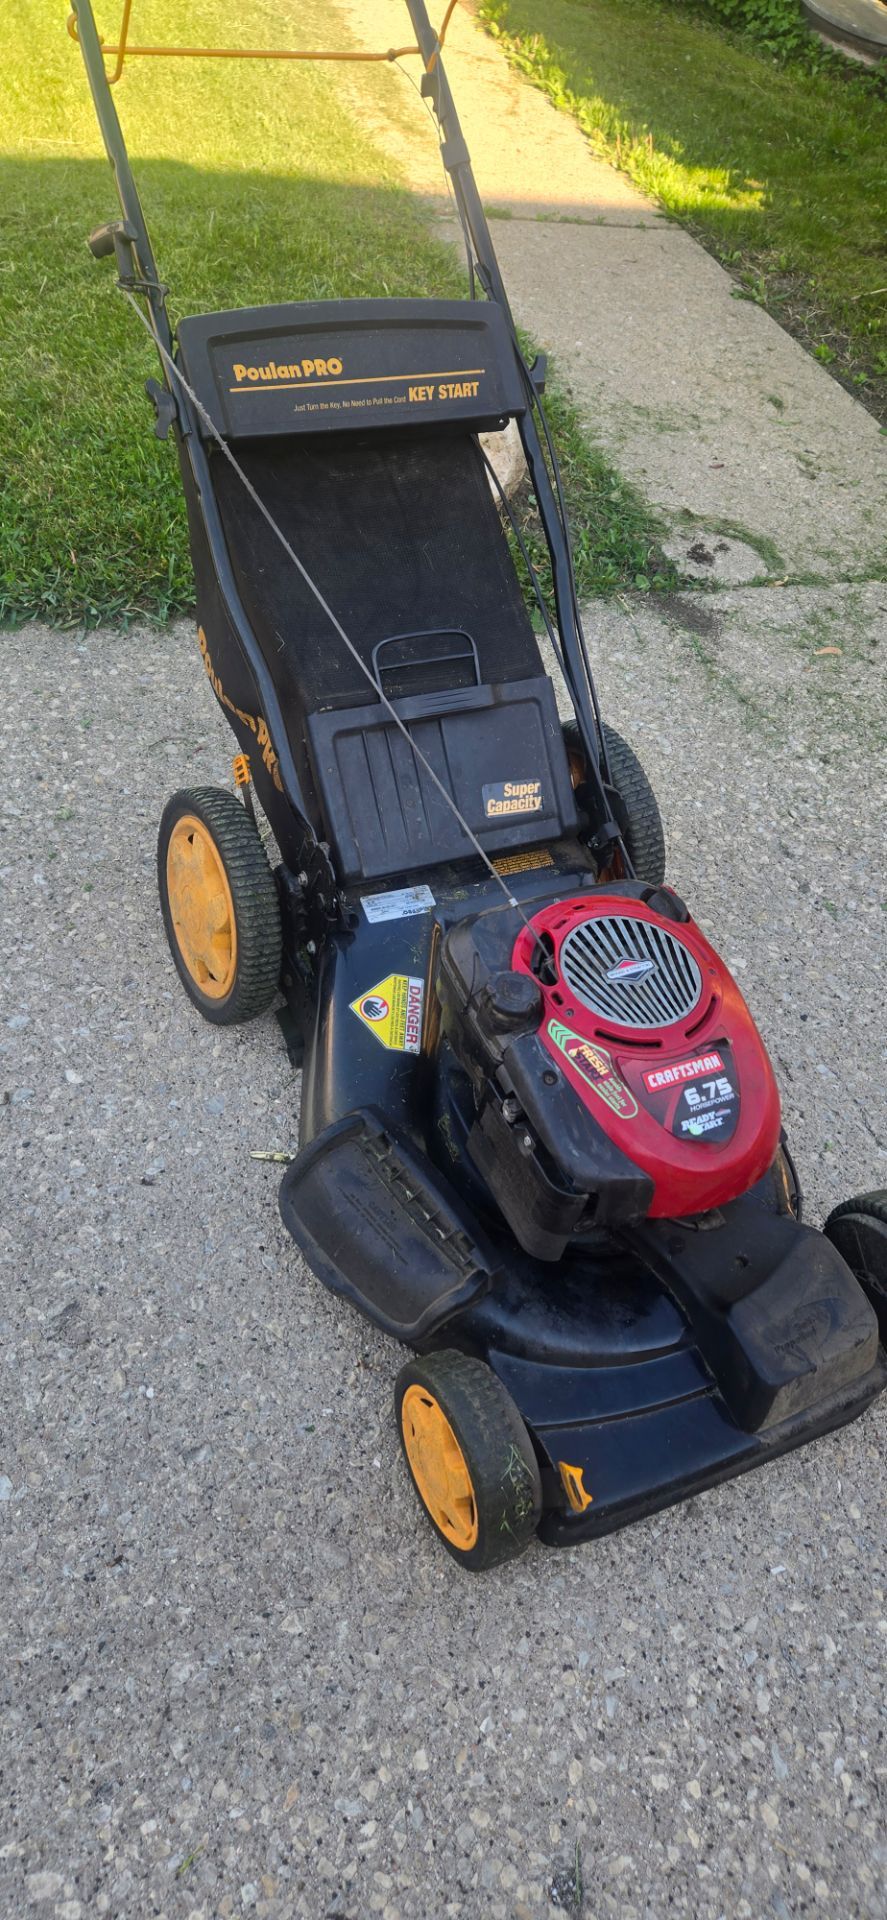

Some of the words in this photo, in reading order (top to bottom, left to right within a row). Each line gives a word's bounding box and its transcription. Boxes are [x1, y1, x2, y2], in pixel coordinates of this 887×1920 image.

[232, 361, 301, 382] Poulan
[301, 357, 343, 377] PRO
[294, 403, 306, 412] Just
[306, 402, 319, 411] Turn
[351, 399, 365, 407] Need
[408, 385, 434, 403] KEY
[438, 382, 480, 400] START
[503, 782, 541, 798] Super
[487, 795, 542, 813] Capacity
[406, 985, 421, 1044] DANGER
[579, 1044, 609, 1075] FRESH
[647, 1054, 721, 1088] CRAFTSMAN
[684, 1077, 733, 1106] 6.75
[690, 1093, 735, 1112] HORSEPOWER
[681, 1111, 716, 1131] READY
